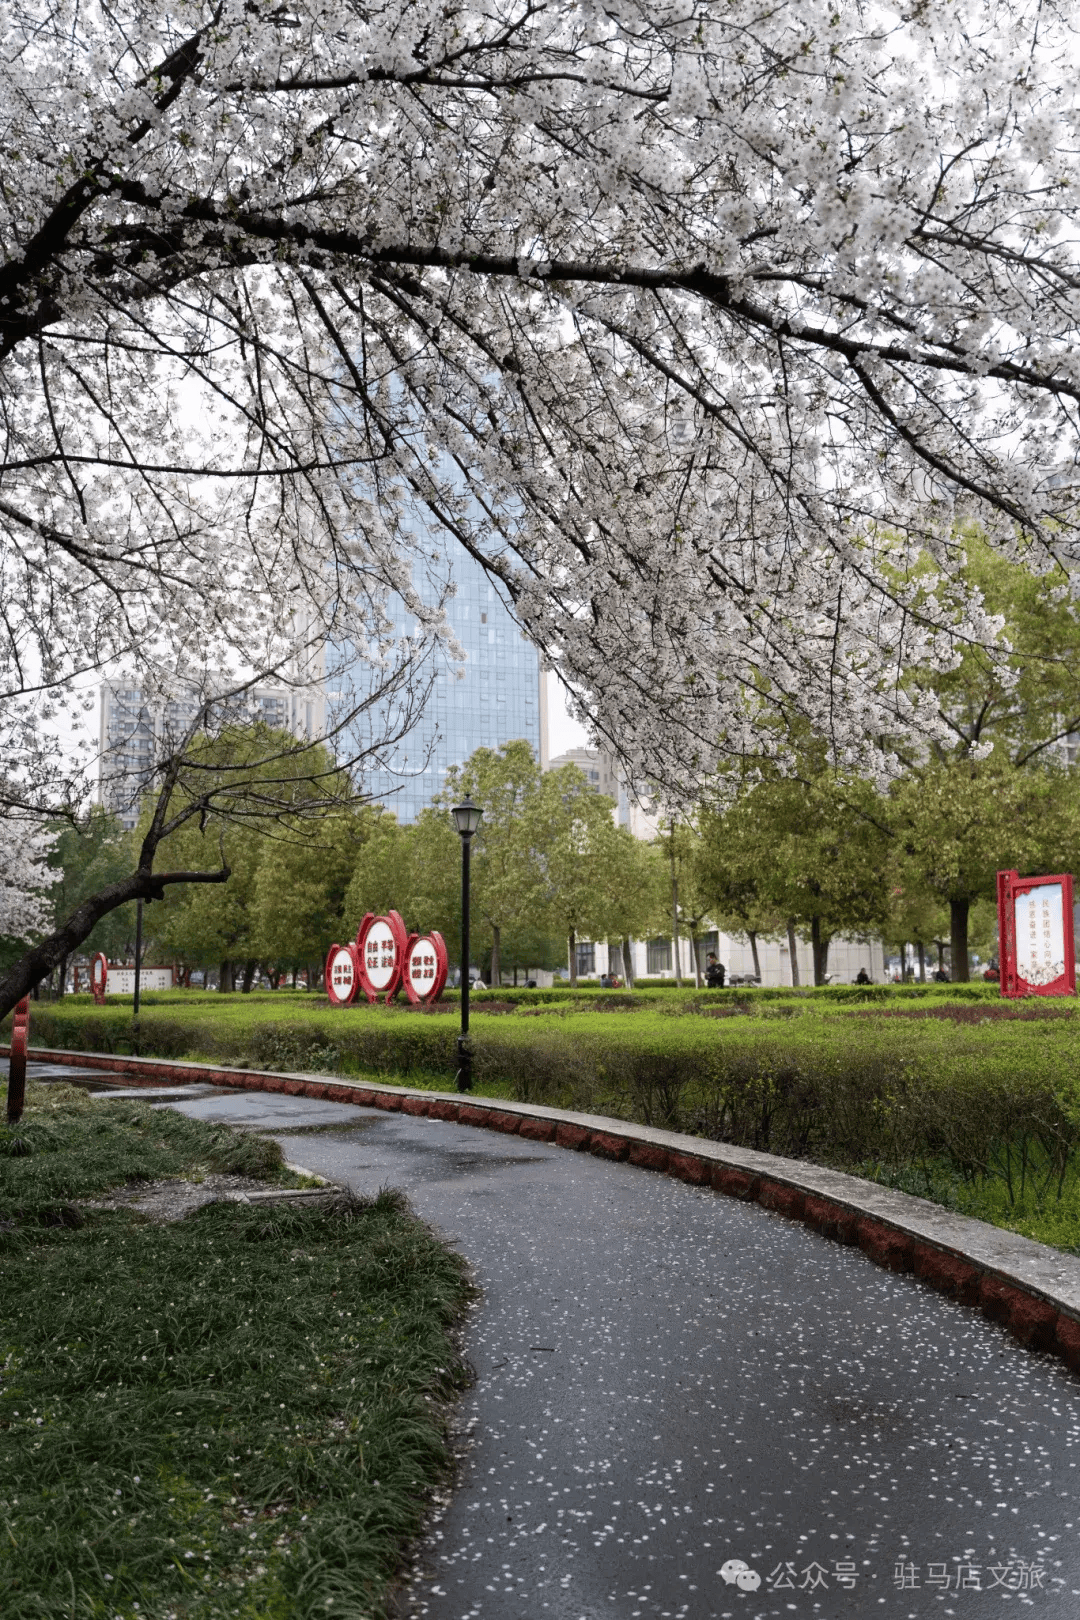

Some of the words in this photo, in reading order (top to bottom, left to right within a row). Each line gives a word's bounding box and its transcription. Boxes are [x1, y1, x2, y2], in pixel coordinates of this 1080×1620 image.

[367, 941, 378, 953] 自由
[381, 940, 394, 952] 平等
[367, 957, 378, 968] 公正
[381, 955, 394, 967] 法治
